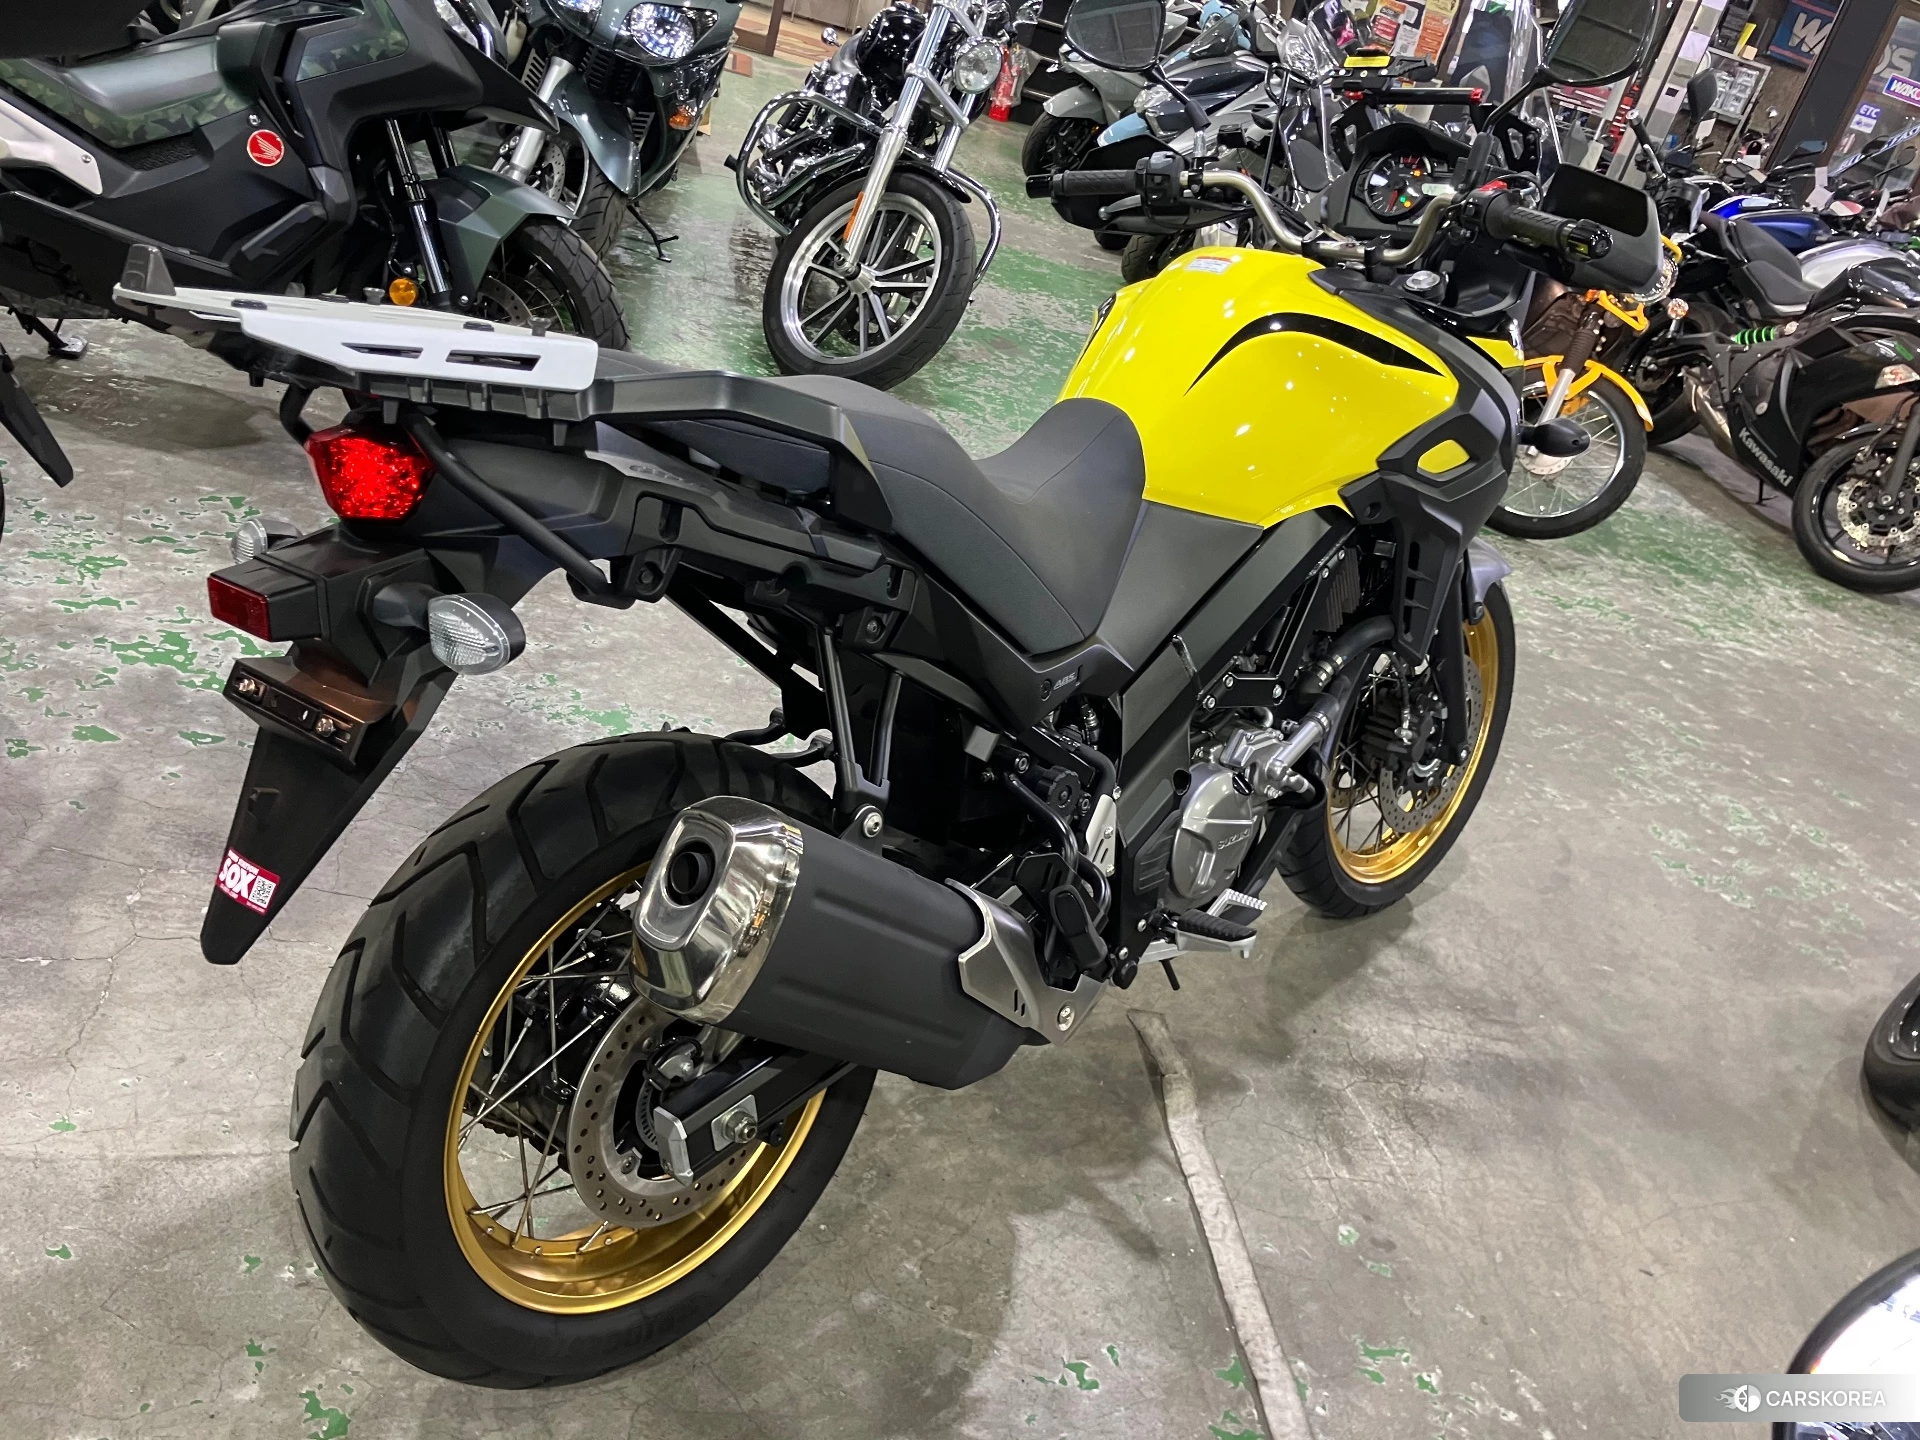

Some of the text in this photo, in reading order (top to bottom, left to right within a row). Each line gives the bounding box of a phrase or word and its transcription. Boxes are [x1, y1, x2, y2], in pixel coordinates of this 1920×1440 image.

[1859, 104, 1881, 118] ETC
[1738, 426, 1794, 487] Kawasaki
[1053, 672, 1077, 690] ABS
[1217, 828, 1250, 850] SUZUKI
[218, 857, 257, 899] SOX
